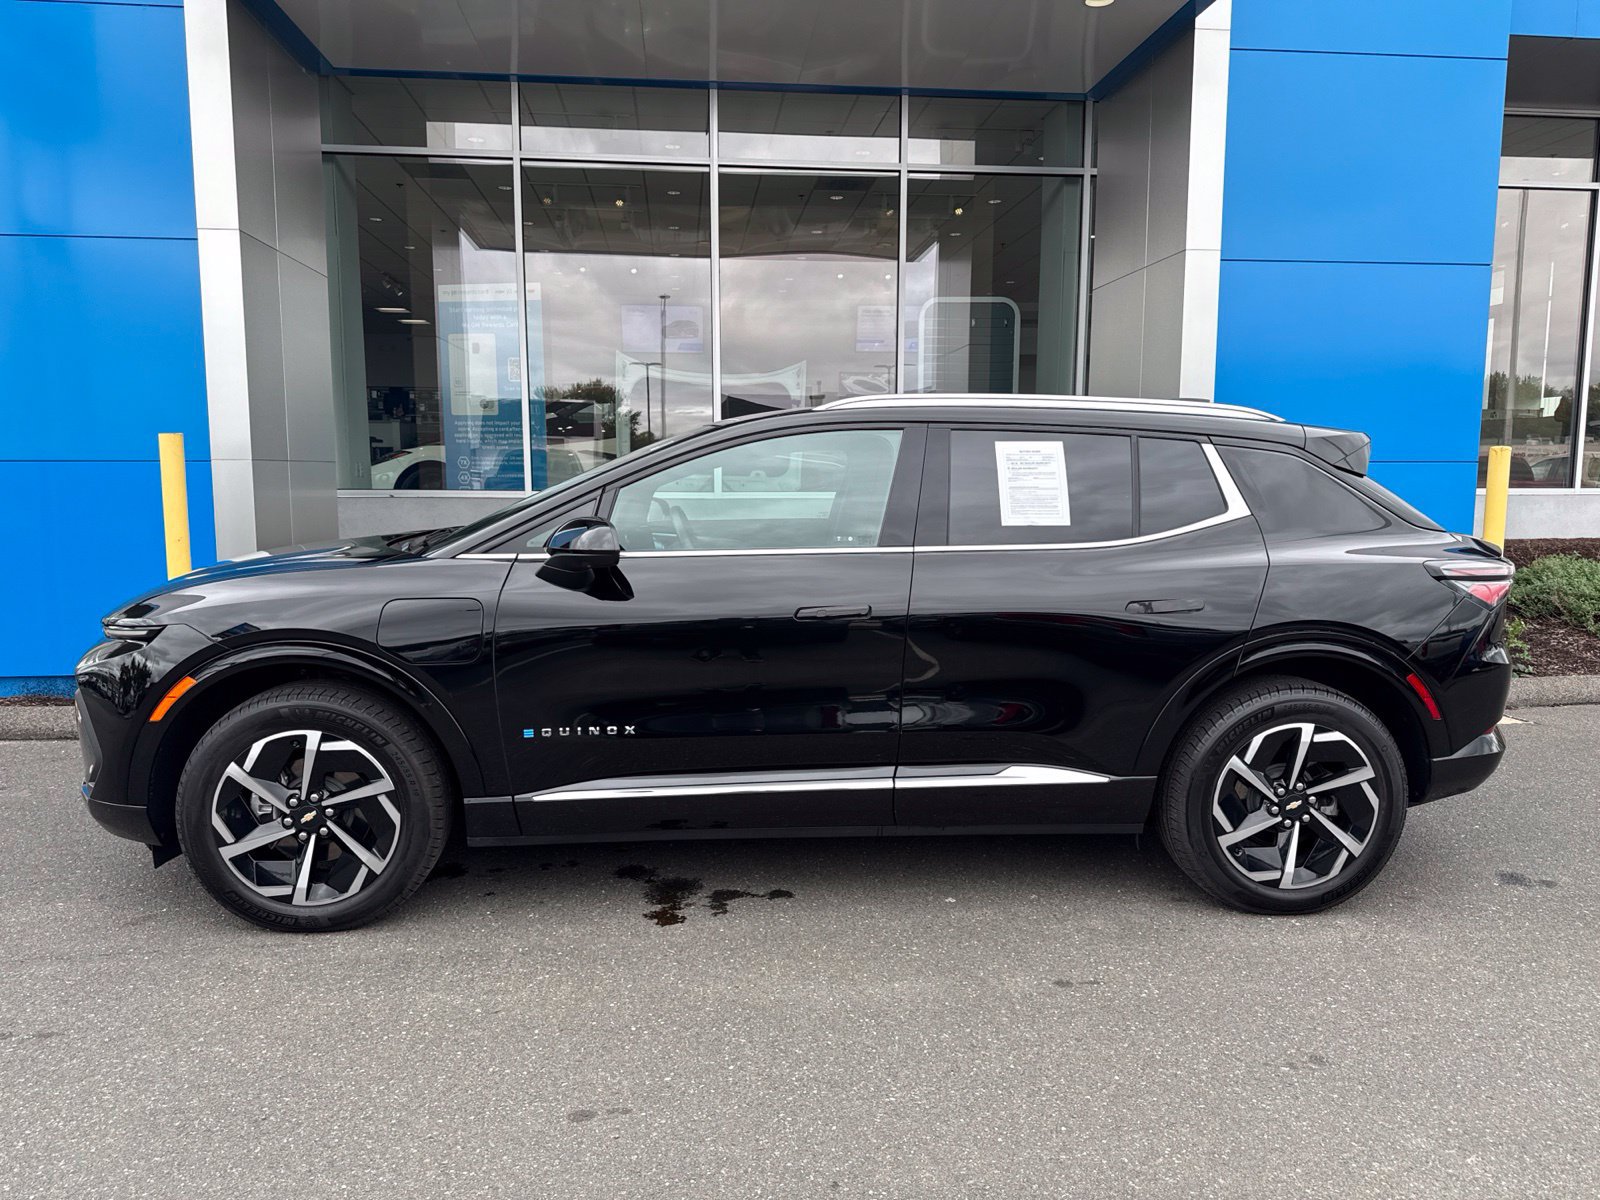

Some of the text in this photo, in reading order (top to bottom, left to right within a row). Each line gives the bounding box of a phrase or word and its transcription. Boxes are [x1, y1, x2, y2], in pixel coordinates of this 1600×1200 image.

[316, 710, 387, 746] MICHELIN
[522, 725, 635, 738] EQUINOX
[225, 891, 298, 926] MICHELIN
